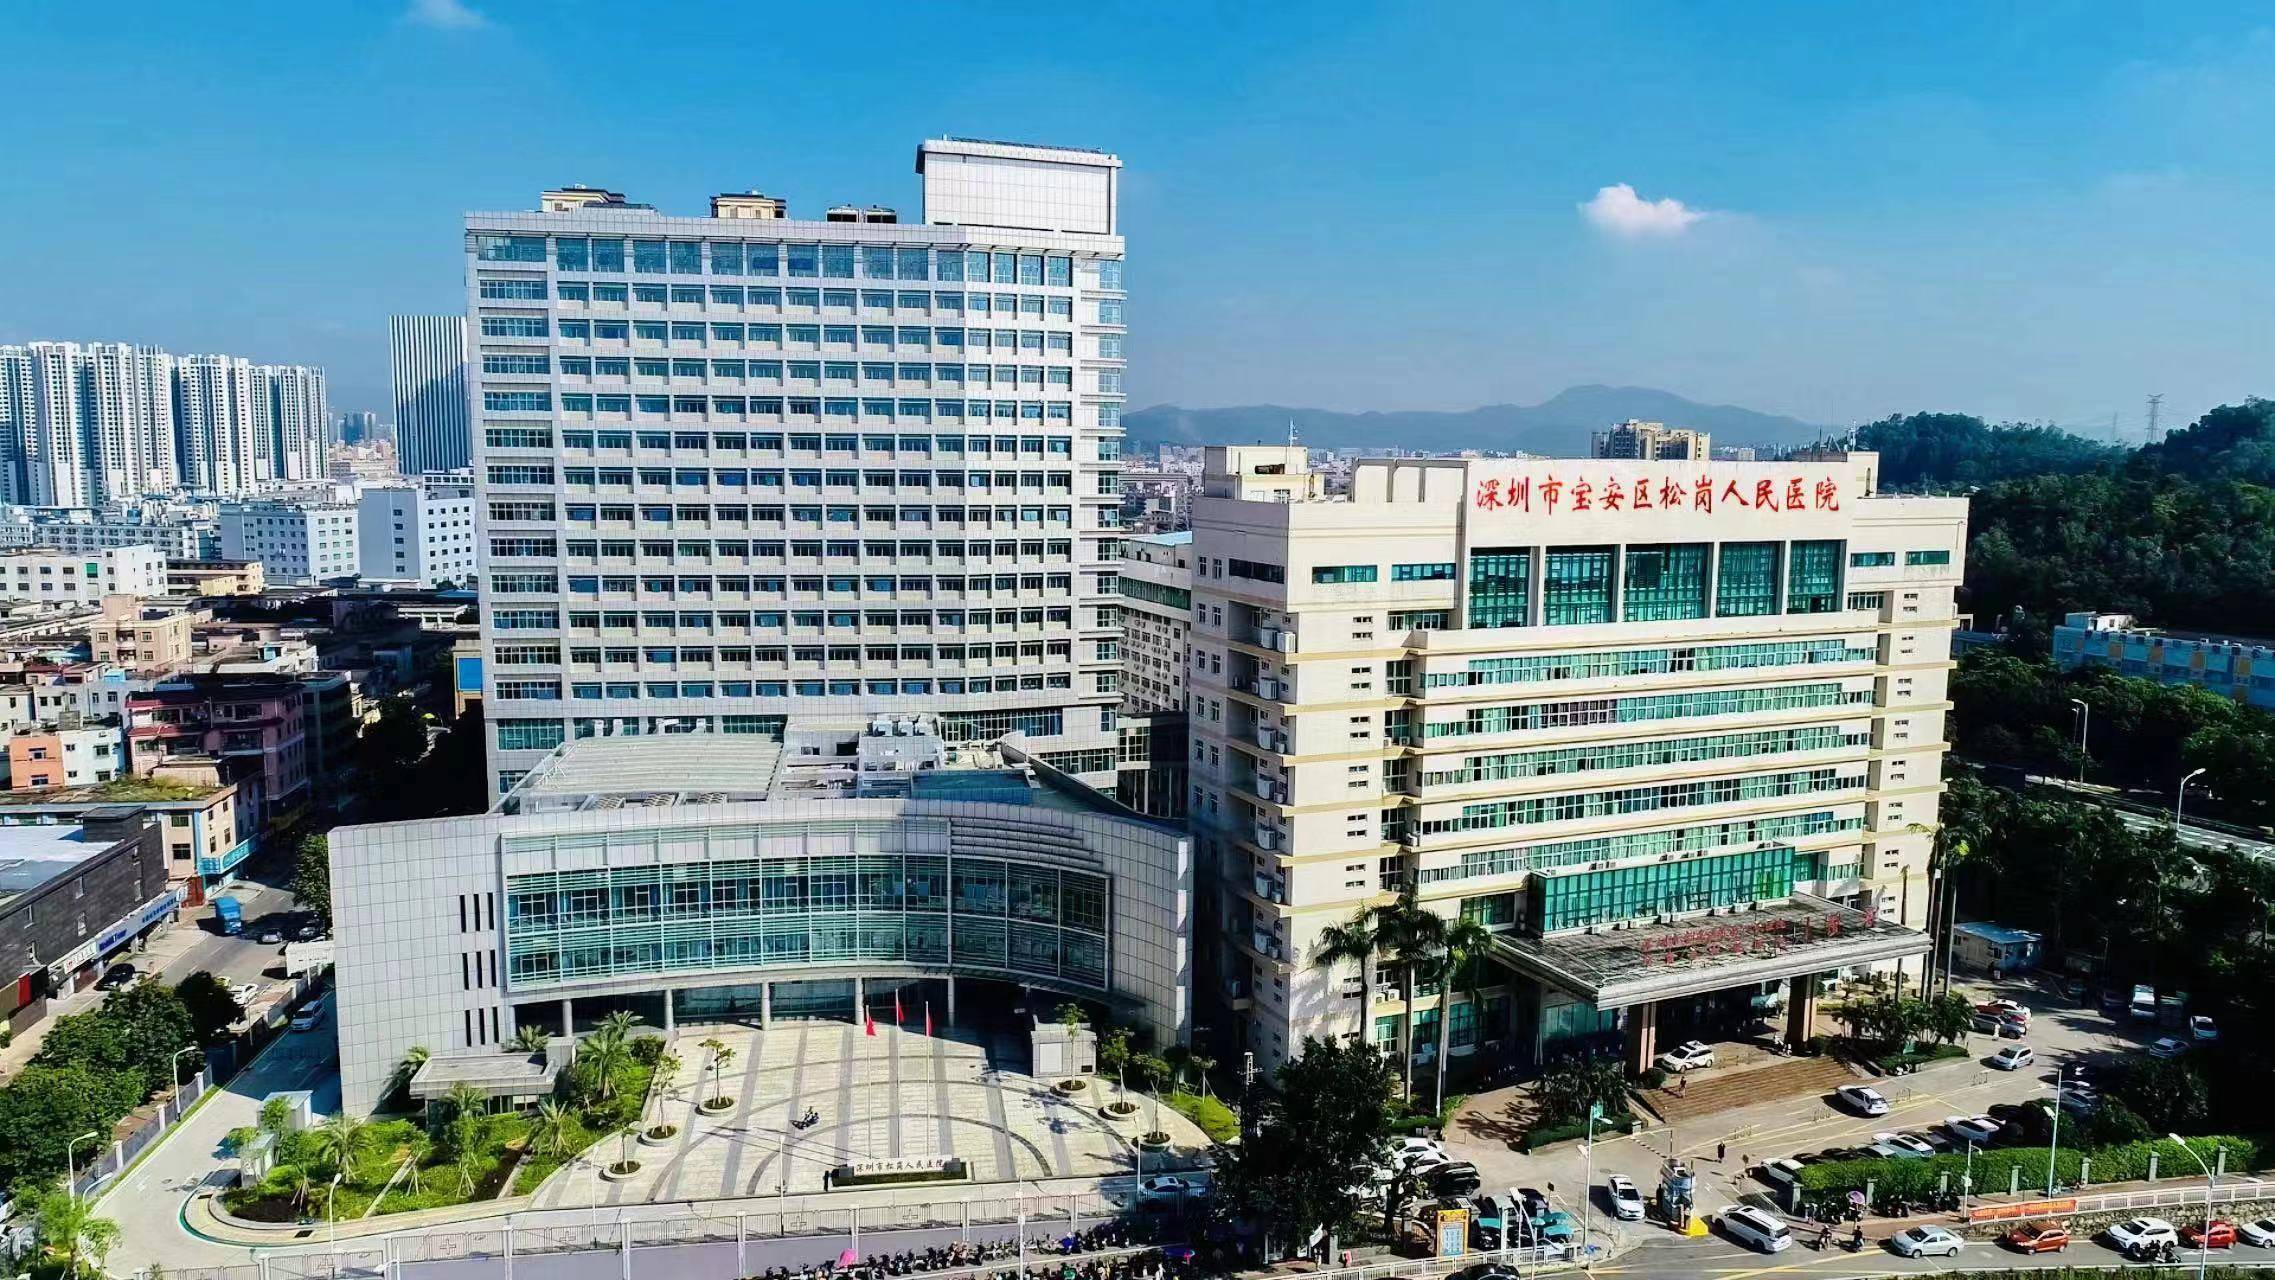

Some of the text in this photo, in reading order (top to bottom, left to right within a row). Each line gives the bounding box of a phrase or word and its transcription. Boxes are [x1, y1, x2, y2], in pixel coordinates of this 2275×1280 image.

[1475, 474, 1840, 515] 深圳市宝安区松岗人民医院
